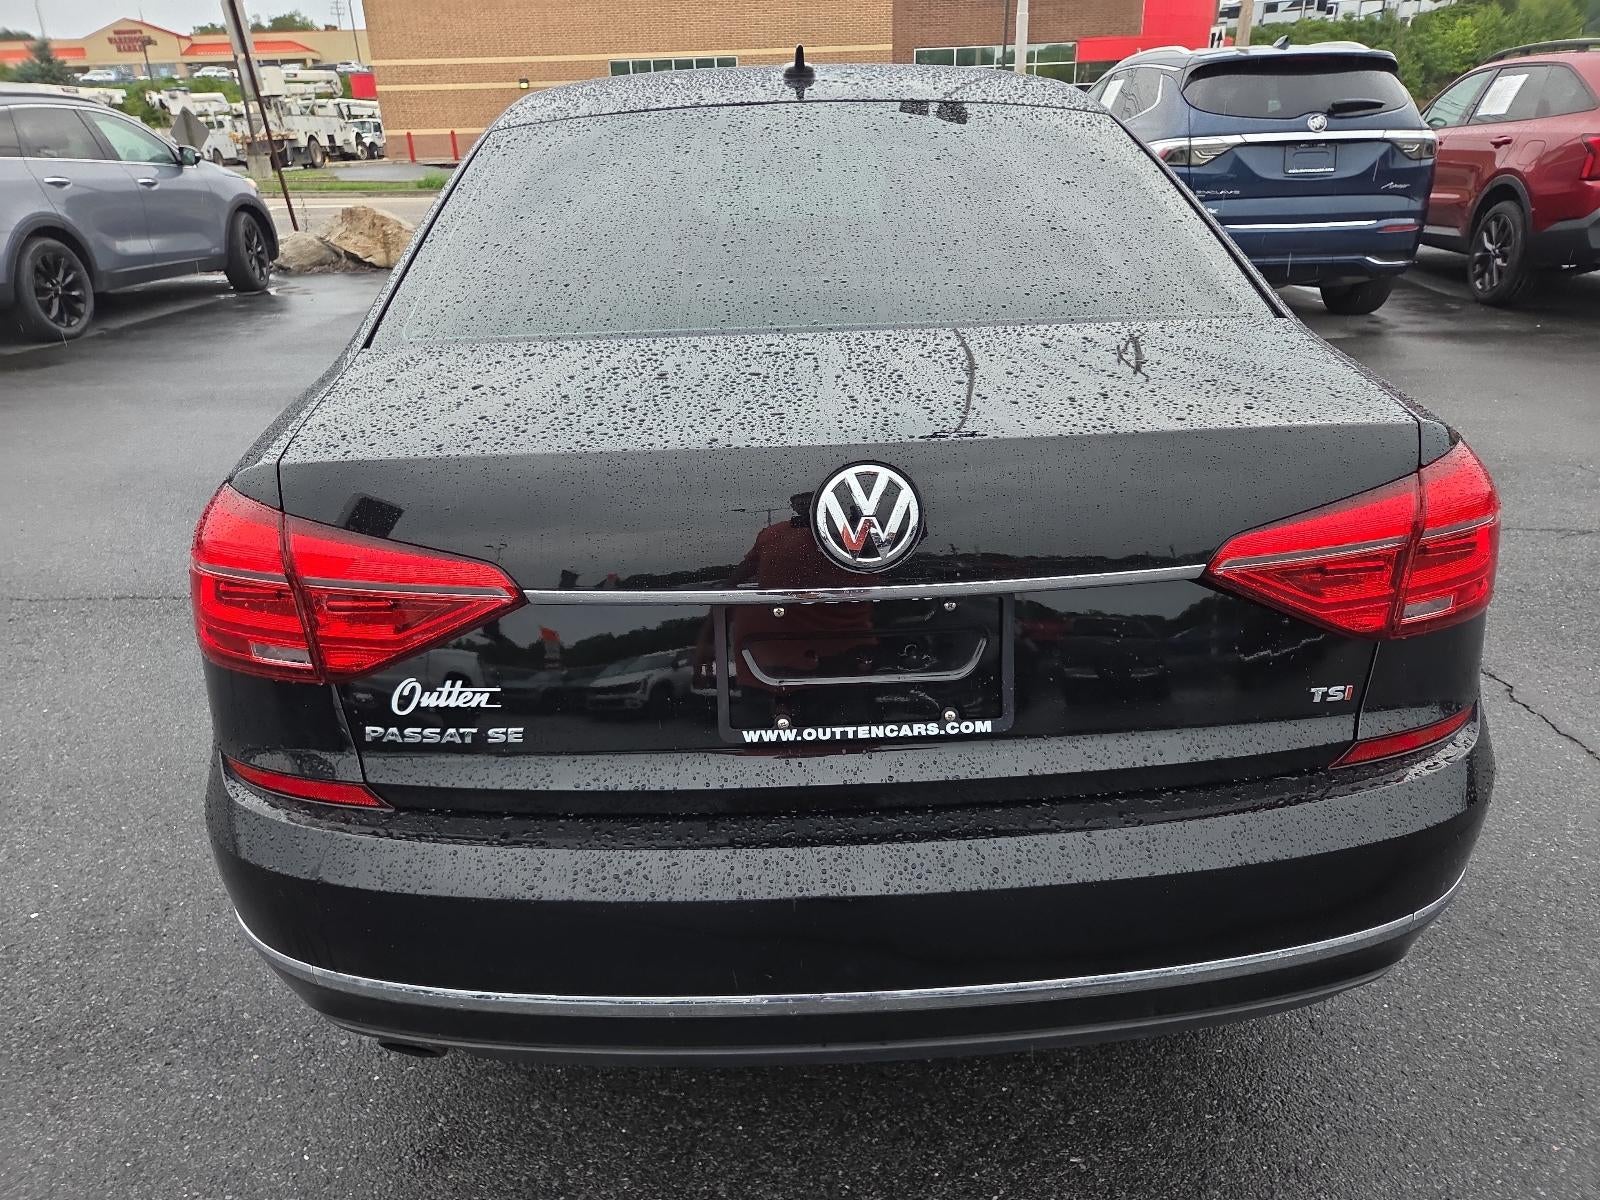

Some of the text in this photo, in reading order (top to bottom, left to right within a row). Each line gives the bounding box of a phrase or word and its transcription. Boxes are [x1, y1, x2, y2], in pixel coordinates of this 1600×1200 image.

[391, 677, 502, 716] Outten
[1310, 685, 1354, 703] TSI
[365, 726, 525, 744] PASSAT SE
[742, 719, 993, 743] WWW.OUTTENCARS.COM
